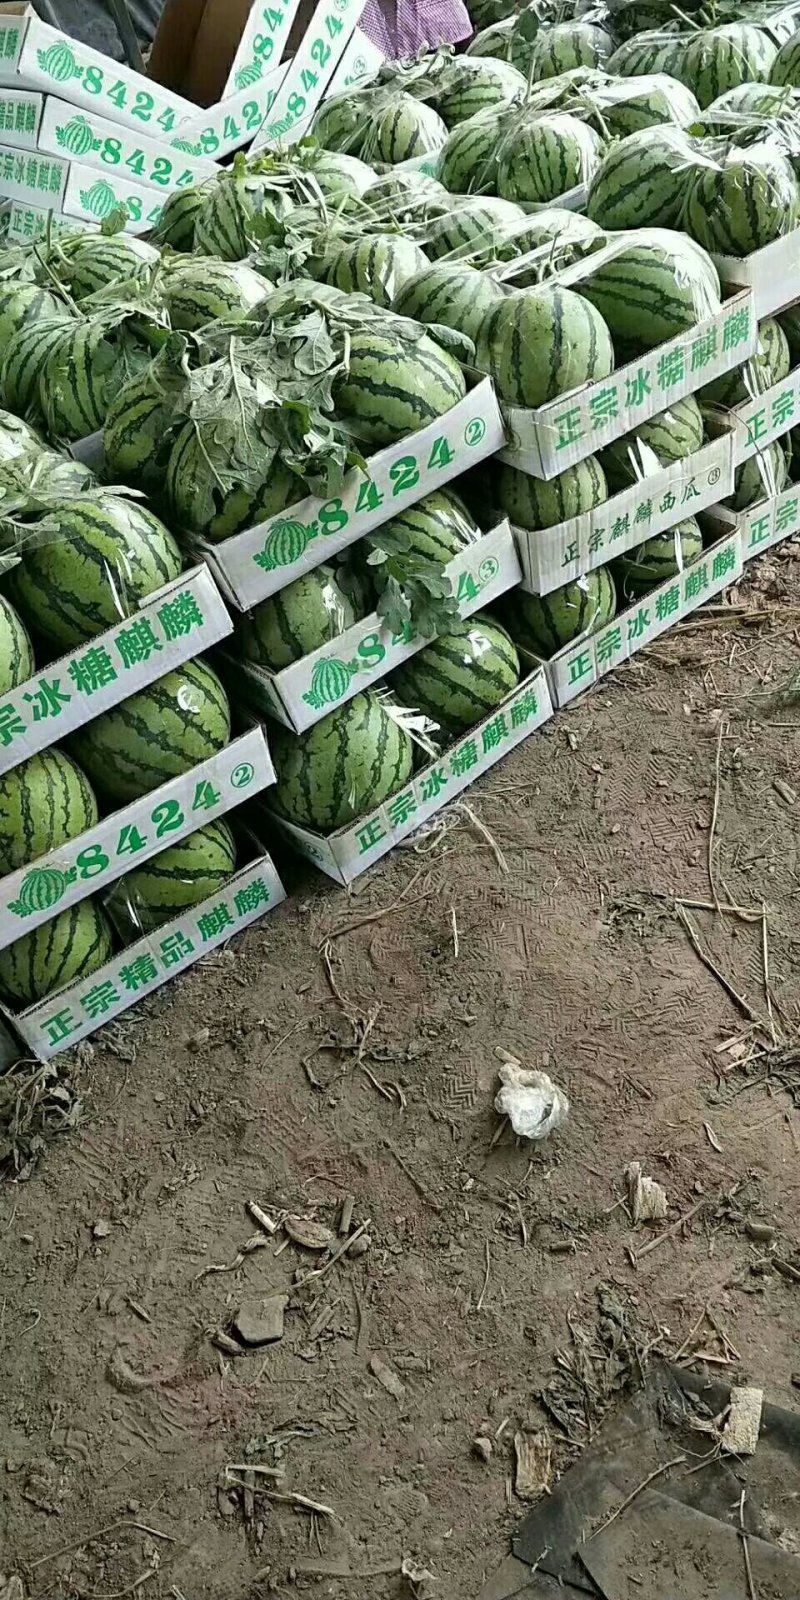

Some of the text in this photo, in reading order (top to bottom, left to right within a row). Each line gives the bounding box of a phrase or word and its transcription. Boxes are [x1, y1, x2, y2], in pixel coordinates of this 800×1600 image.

[253, 0, 292, 60] 84
[286, 14, 345, 118] 8424
[81, 65, 176, 134] 8424
[554, 305, 751, 451] 正宗冰糖麒麟
[317, 435, 456, 537] 8424
[559, 476, 703, 569] 正宗麒麟西瓜
[567, 547, 739, 687] 正宗冰糖麒麟
[354, 686, 542, 855] 正宗冰糖麒麟
[75, 779, 221, 882] 8424
[40, 876, 272, 1048] 正宗精品麒麟
